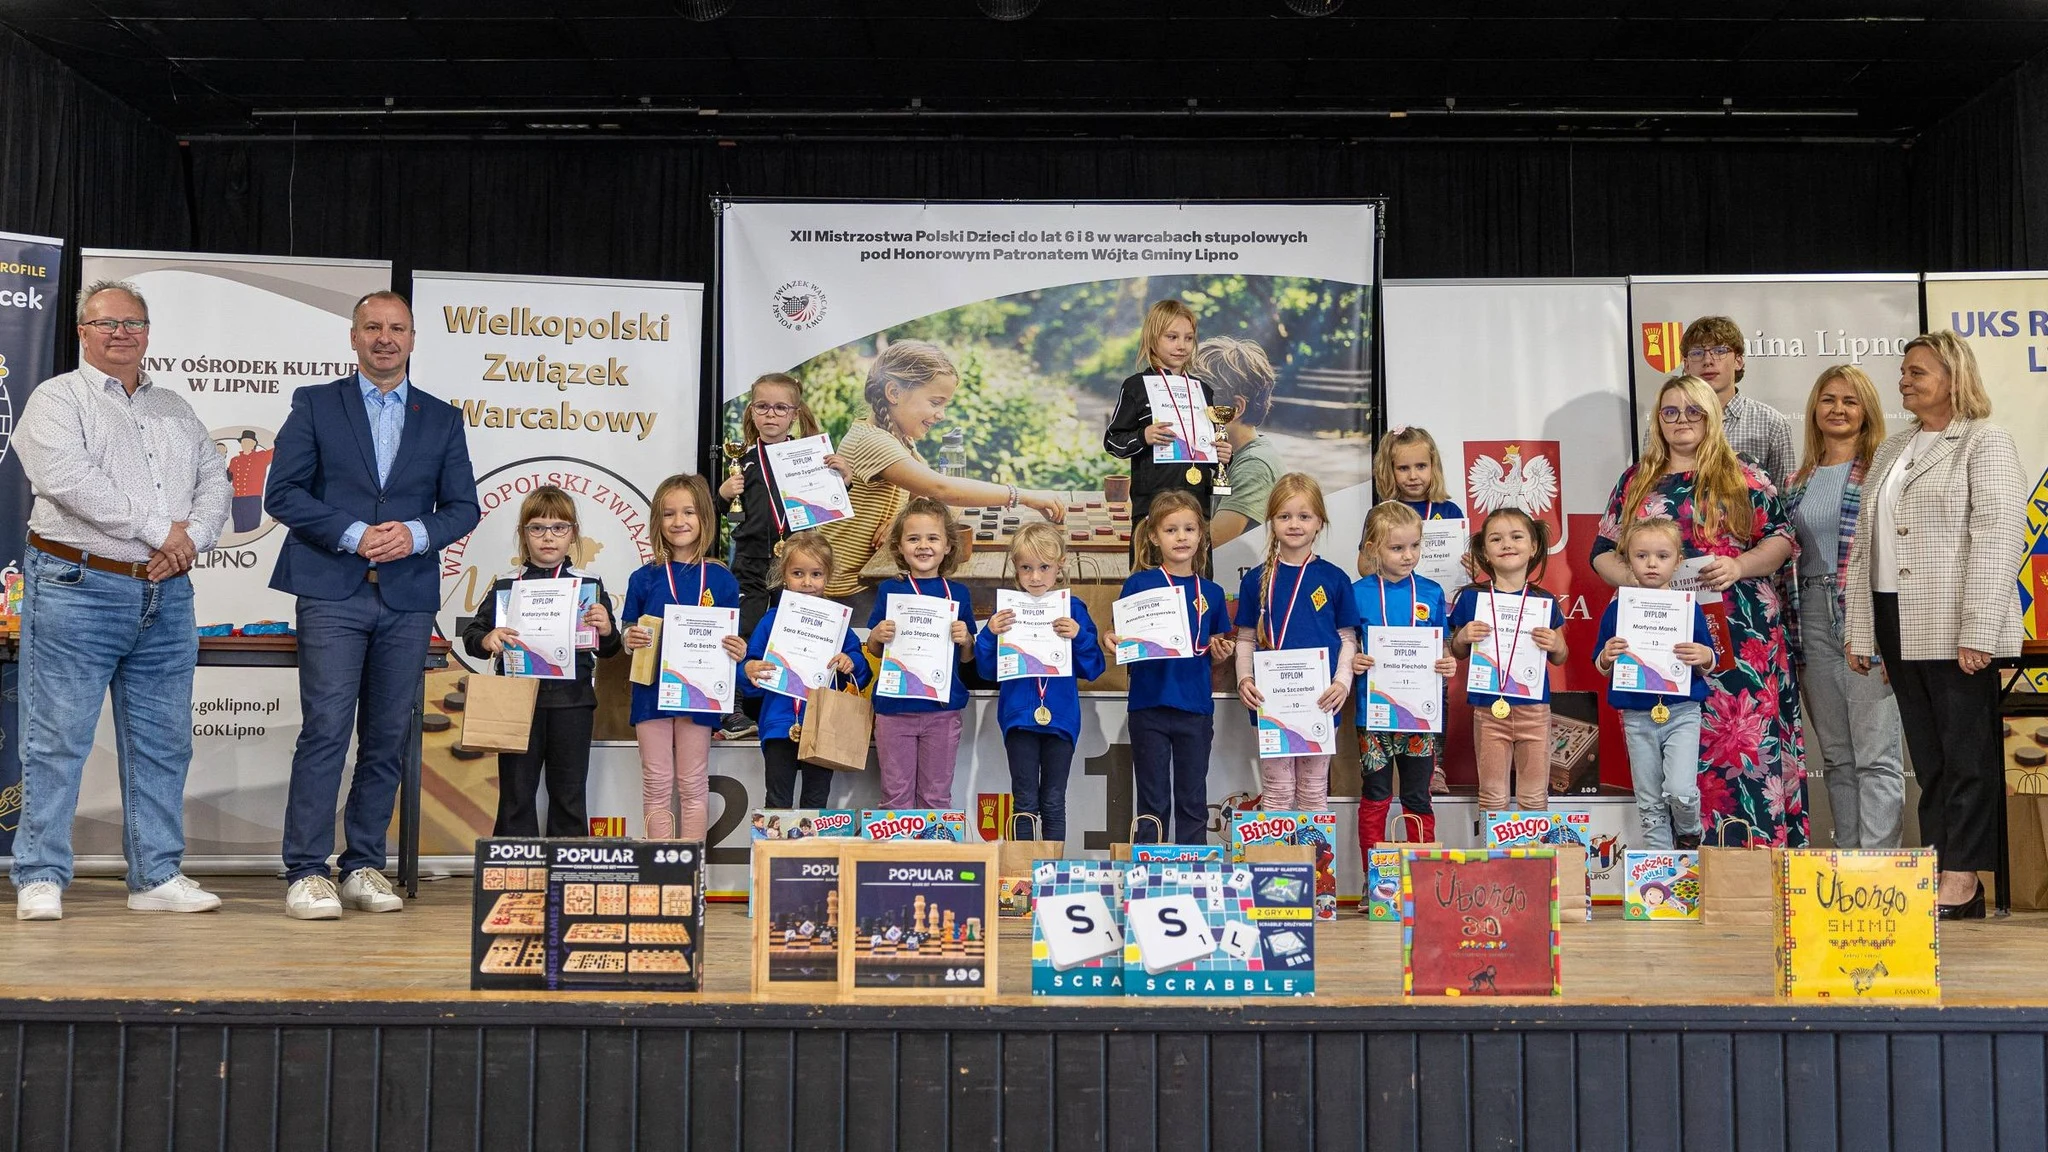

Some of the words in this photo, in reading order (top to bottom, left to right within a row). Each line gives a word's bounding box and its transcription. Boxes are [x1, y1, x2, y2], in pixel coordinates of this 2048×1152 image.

[790, 230, 811, 242] XII
[815, 230, 913, 242] Mistrzostwa
[916, 230, 964, 242] Polski
[967, 231, 1015, 242] Dzieci
[1018, 231, 1038, 242] do
[1041, 231, 1063, 242] lat
[1064, 231, 1075, 242] 6
[1077, 231, 1082, 242] i
[1084, 231, 1095, 242] 8
[1098, 233, 1112, 242] w
[1114, 231, 1201, 243] warcabach
[1204, 231, 1308, 245] stupolowych
[860, 248, 890, 262] pod
[893, 248, 991, 262] Honorowym
[993, 248, 1088, 261] Patronatem
[1091, 248, 1138, 262] Wójta
[1141, 248, 1192, 262] Gminy
[1195, 248, 1239, 262] Lipno
[0, 262, 46, 278] ROFILE
[443, 305, 670, 344] Wielkopolski
[1951, 310, 2020, 337] UKS
[744, 330, 807, 357] ina
[1815, 329, 1909, 365] Lipno
[181, 355, 277, 375] OŚRODEK
[482, 353, 629, 391] Związek
[187, 378, 208, 392] W
[213, 378, 279, 394] LIPNIE
[451, 398, 658, 441] Warcabowy
[792, 456, 813, 466] DYPLOM
[442, 472, 592, 579] WIEOPOLSKI
[592, 484, 655, 565] ZWIĄZE
[194, 550, 257, 569] LIPNO
[1137, 602, 1160, 612] DYPLOM
[1643, 610, 1668, 619] DYPLOM
[800, 616, 823, 628] DYPLOM
[909, 616, 933, 625] DYPLOM
[1632, 623, 1657, 631] Martyna
[689, 628, 712, 637] DYPLOM
[783, 626, 796, 634] Sara
[1394, 648, 1417, 657] DYPLOM
[1280, 671, 1304, 680] DYPLOM
[813, 815, 850, 831] Bingo
[868, 816, 925, 841] Bingo
[1238, 818, 1296, 842] Bingo
[1492, 818, 1550, 842] Bingo
[490, 845, 547, 859] POPUL
[556, 848, 634, 863] POPULAR
[888, 868, 954, 881] POPULAR
[1435, 867, 1526, 916] Ubongo
[1815, 869, 1907, 917] Ubongo
[1065, 904, 1095, 934] S
[1158, 907, 1188, 938] S
[1462, 916, 1501, 937] 3D
[1828, 919, 1896, 932] SHIMO
[1231, 931, 1241, 948] L
[1054, 975, 1122, 987] SCRA
[1146, 978, 1295, 991] SCRABBLE
[1894, 988, 1931, 996] EGMONT
